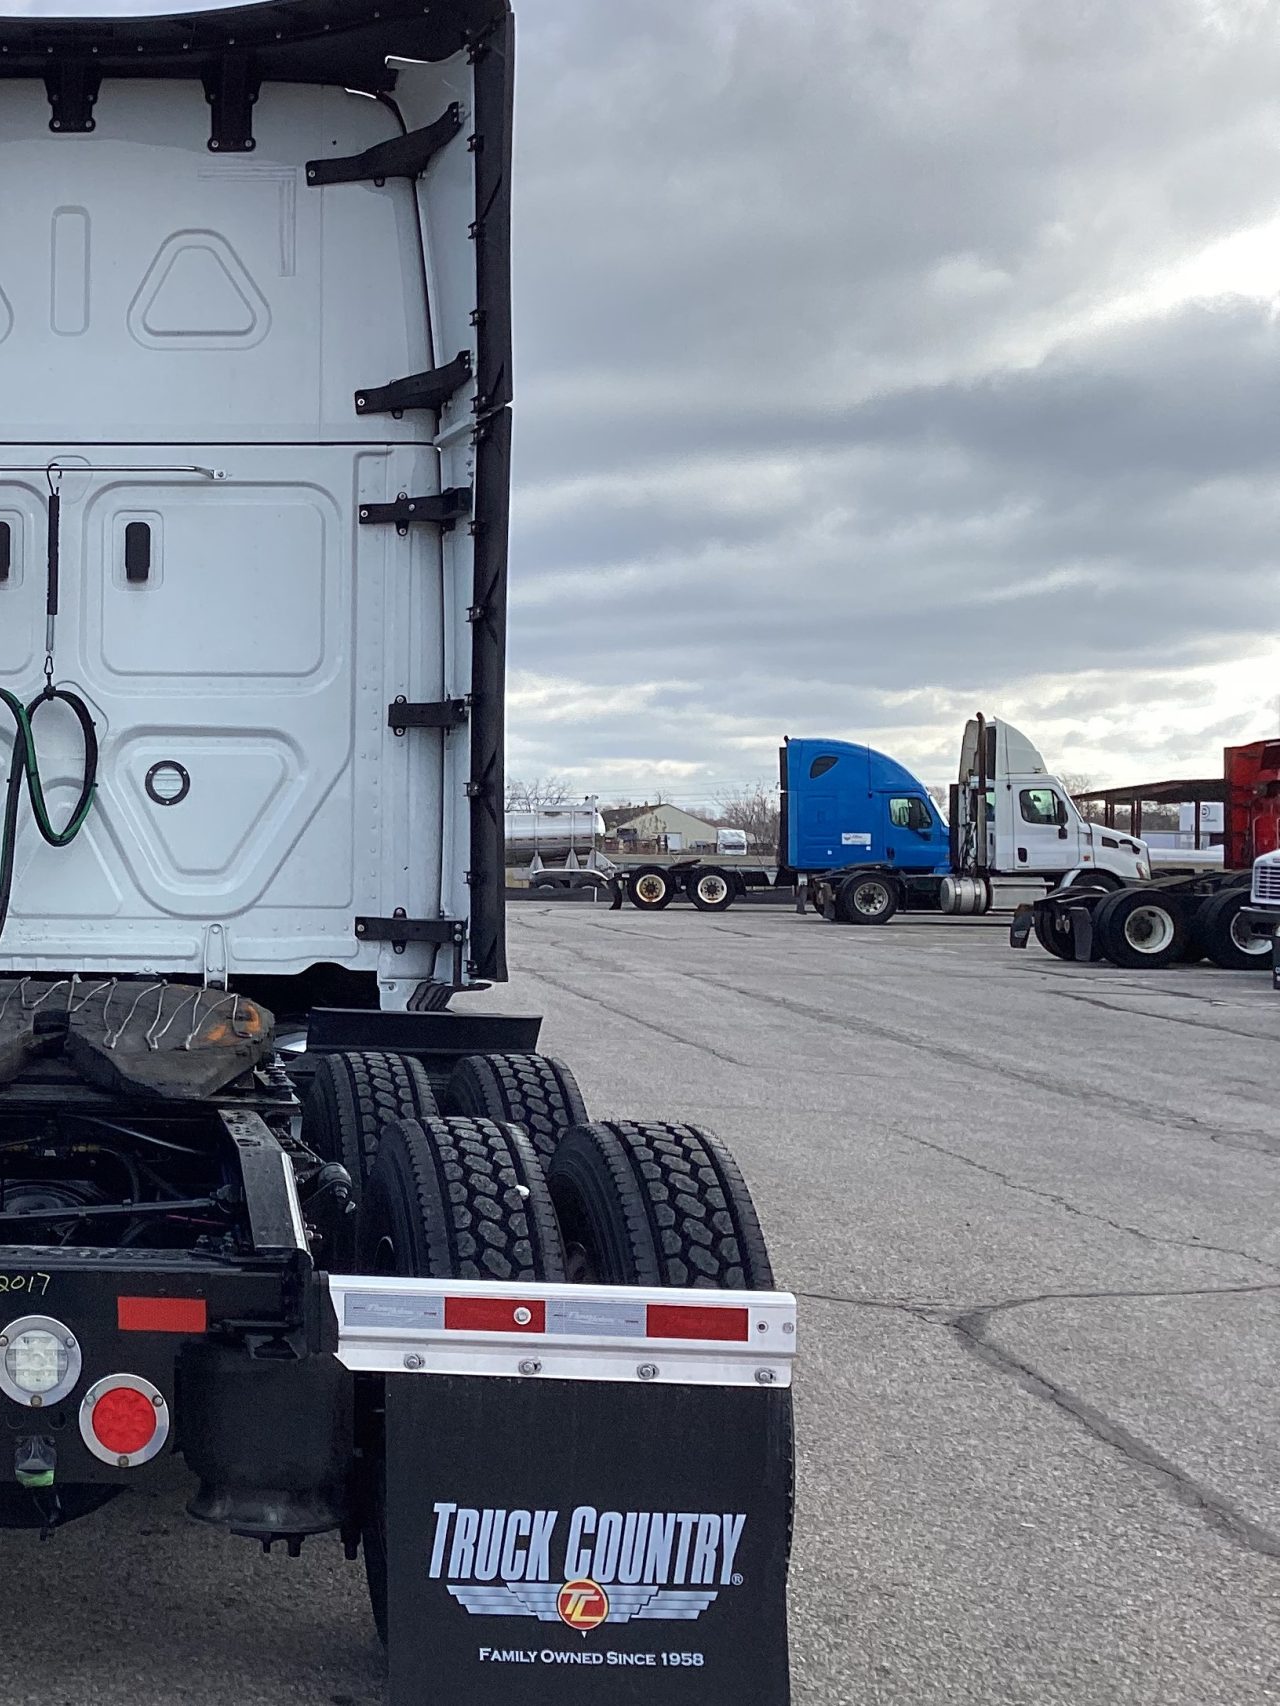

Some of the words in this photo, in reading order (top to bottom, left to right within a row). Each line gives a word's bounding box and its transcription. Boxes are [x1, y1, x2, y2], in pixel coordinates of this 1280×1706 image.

[428, 1502, 559, 1581] TRUCK
[479, 1647, 538, 1664] FAMILY
[540, 1649, 604, 1665] OWNED
[606, 1651, 657, 1666] SINCE
[661, 1652, 705, 1667] 1958
